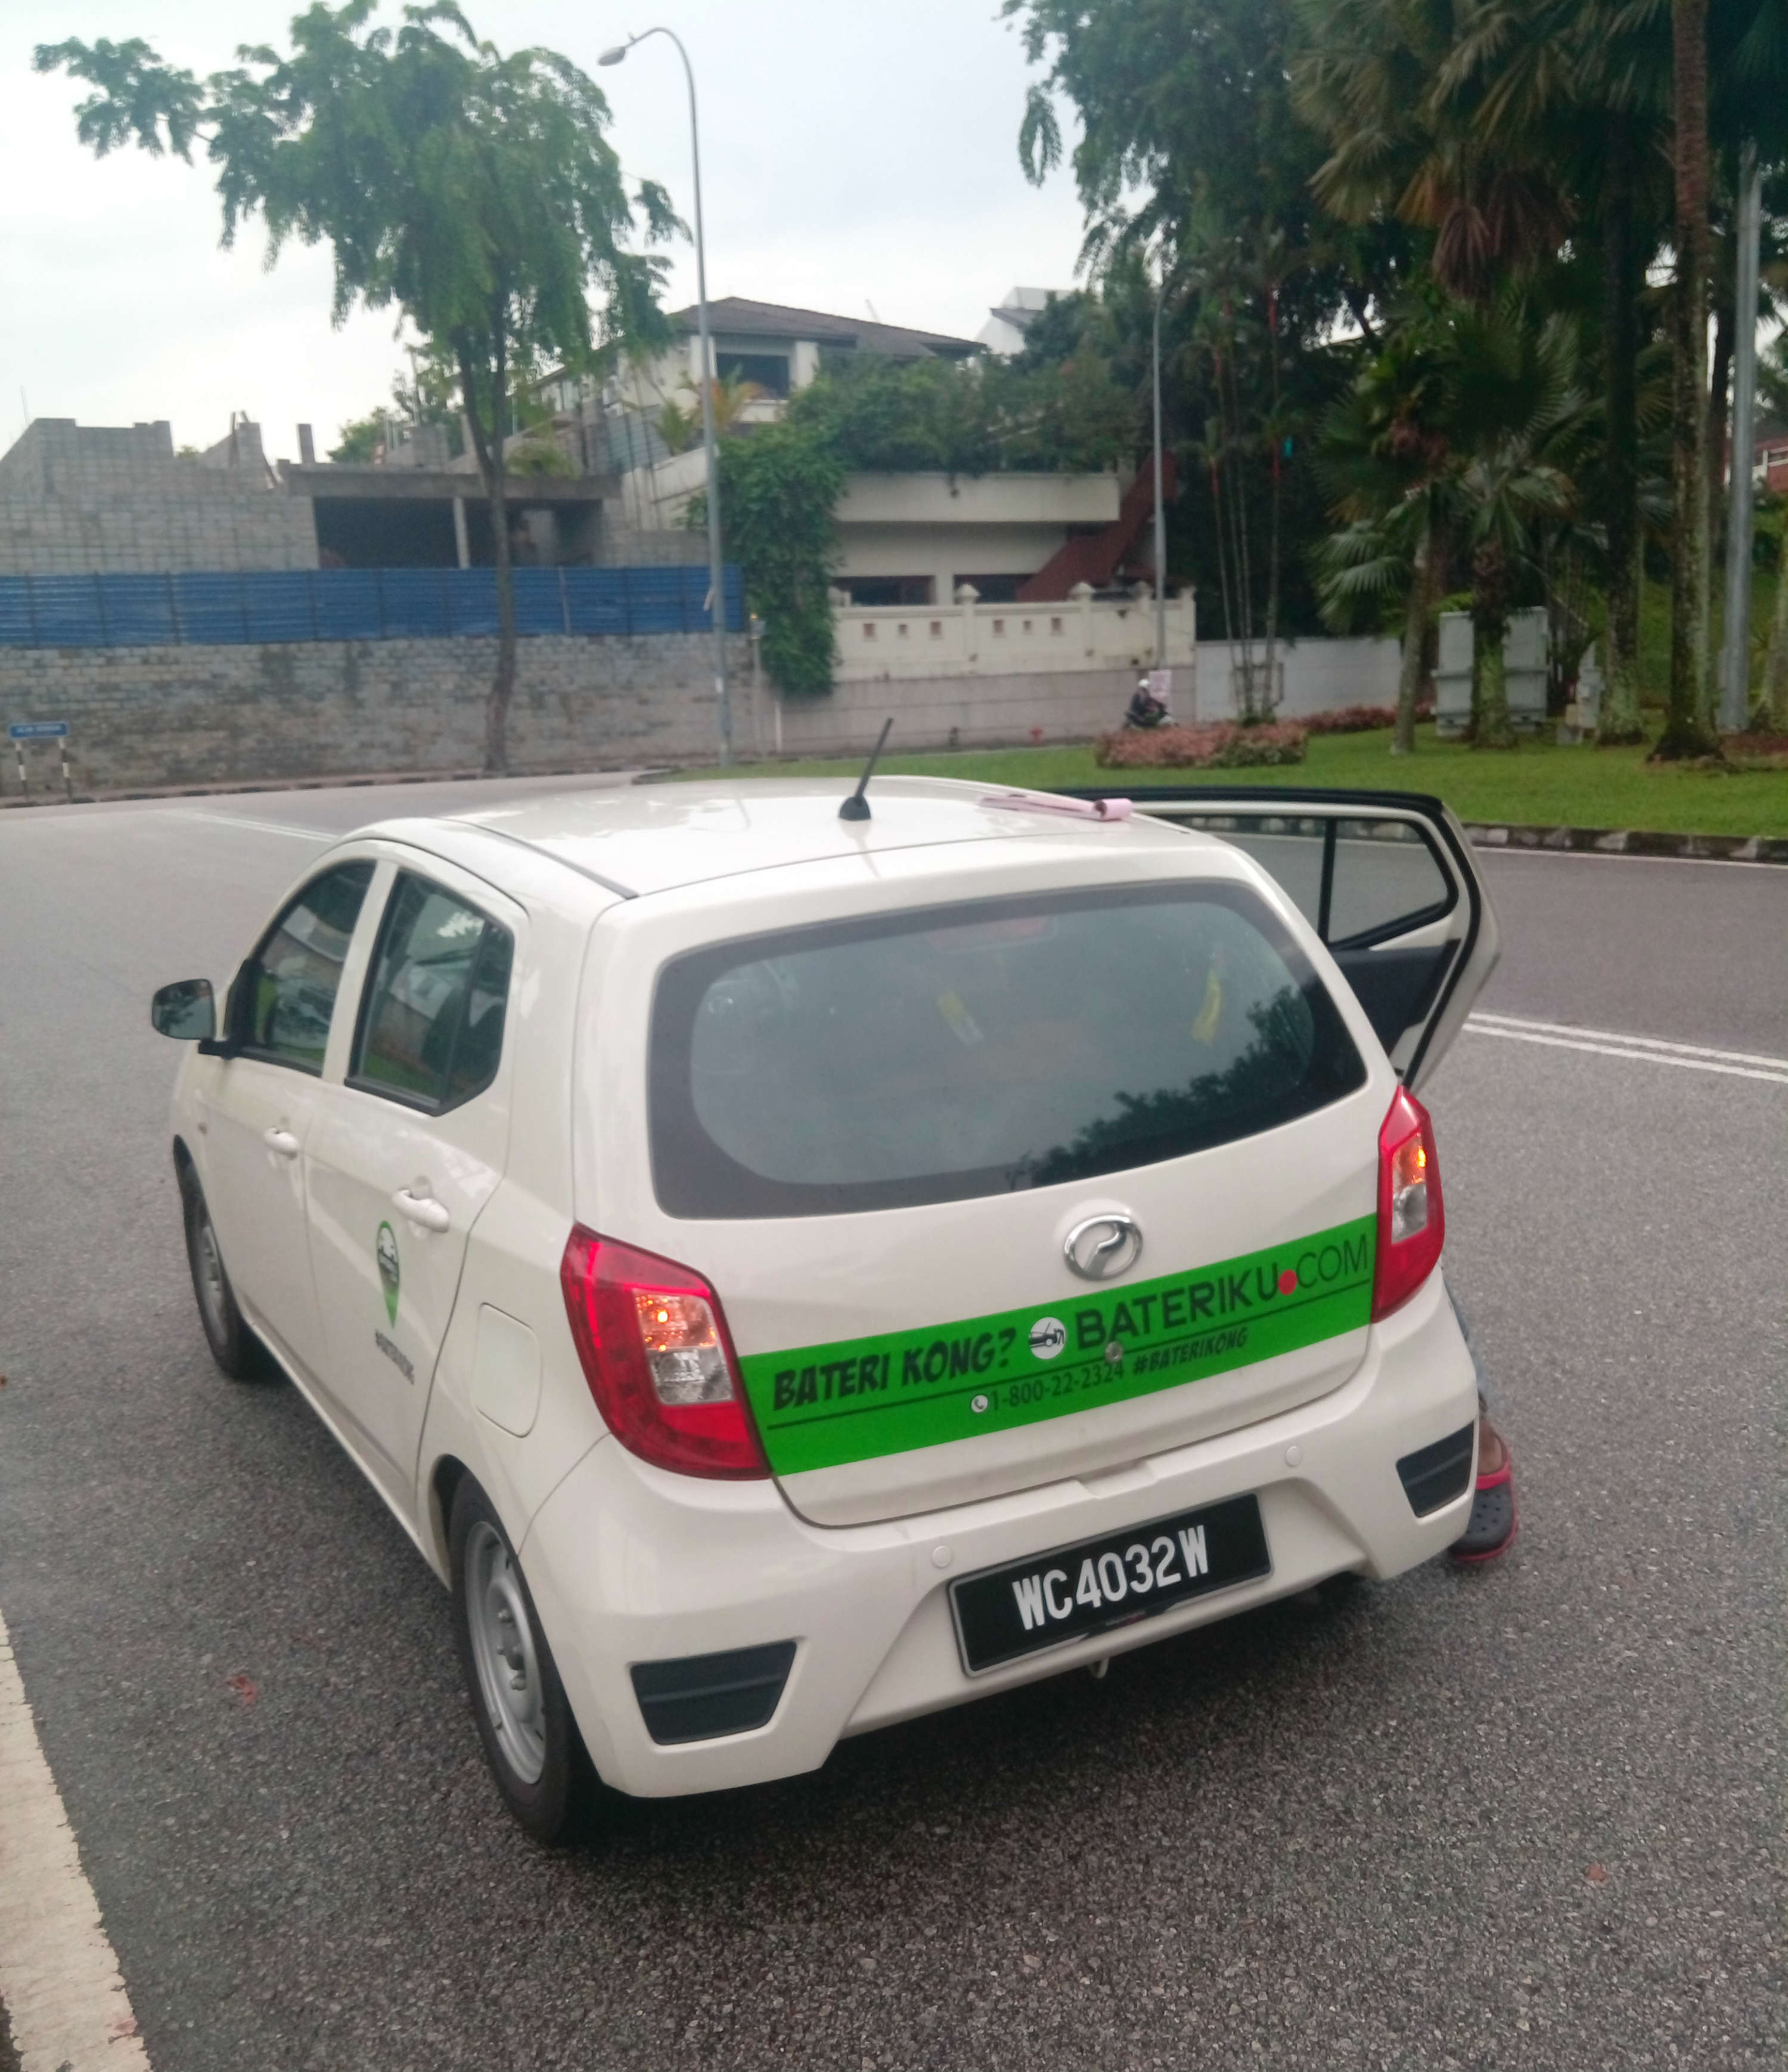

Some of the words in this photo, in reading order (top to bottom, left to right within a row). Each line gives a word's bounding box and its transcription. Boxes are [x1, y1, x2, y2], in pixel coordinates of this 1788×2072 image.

[772, 1352, 892, 1411] BATERI
[901, 1327, 1017, 1387] KONG?
[992, 1361, 1124, 1411] 1-800-22-2324
[1133, 1327, 1249, 1373] #BATERIKONG
[1011, 1524, 1209, 1630] WC4032W
